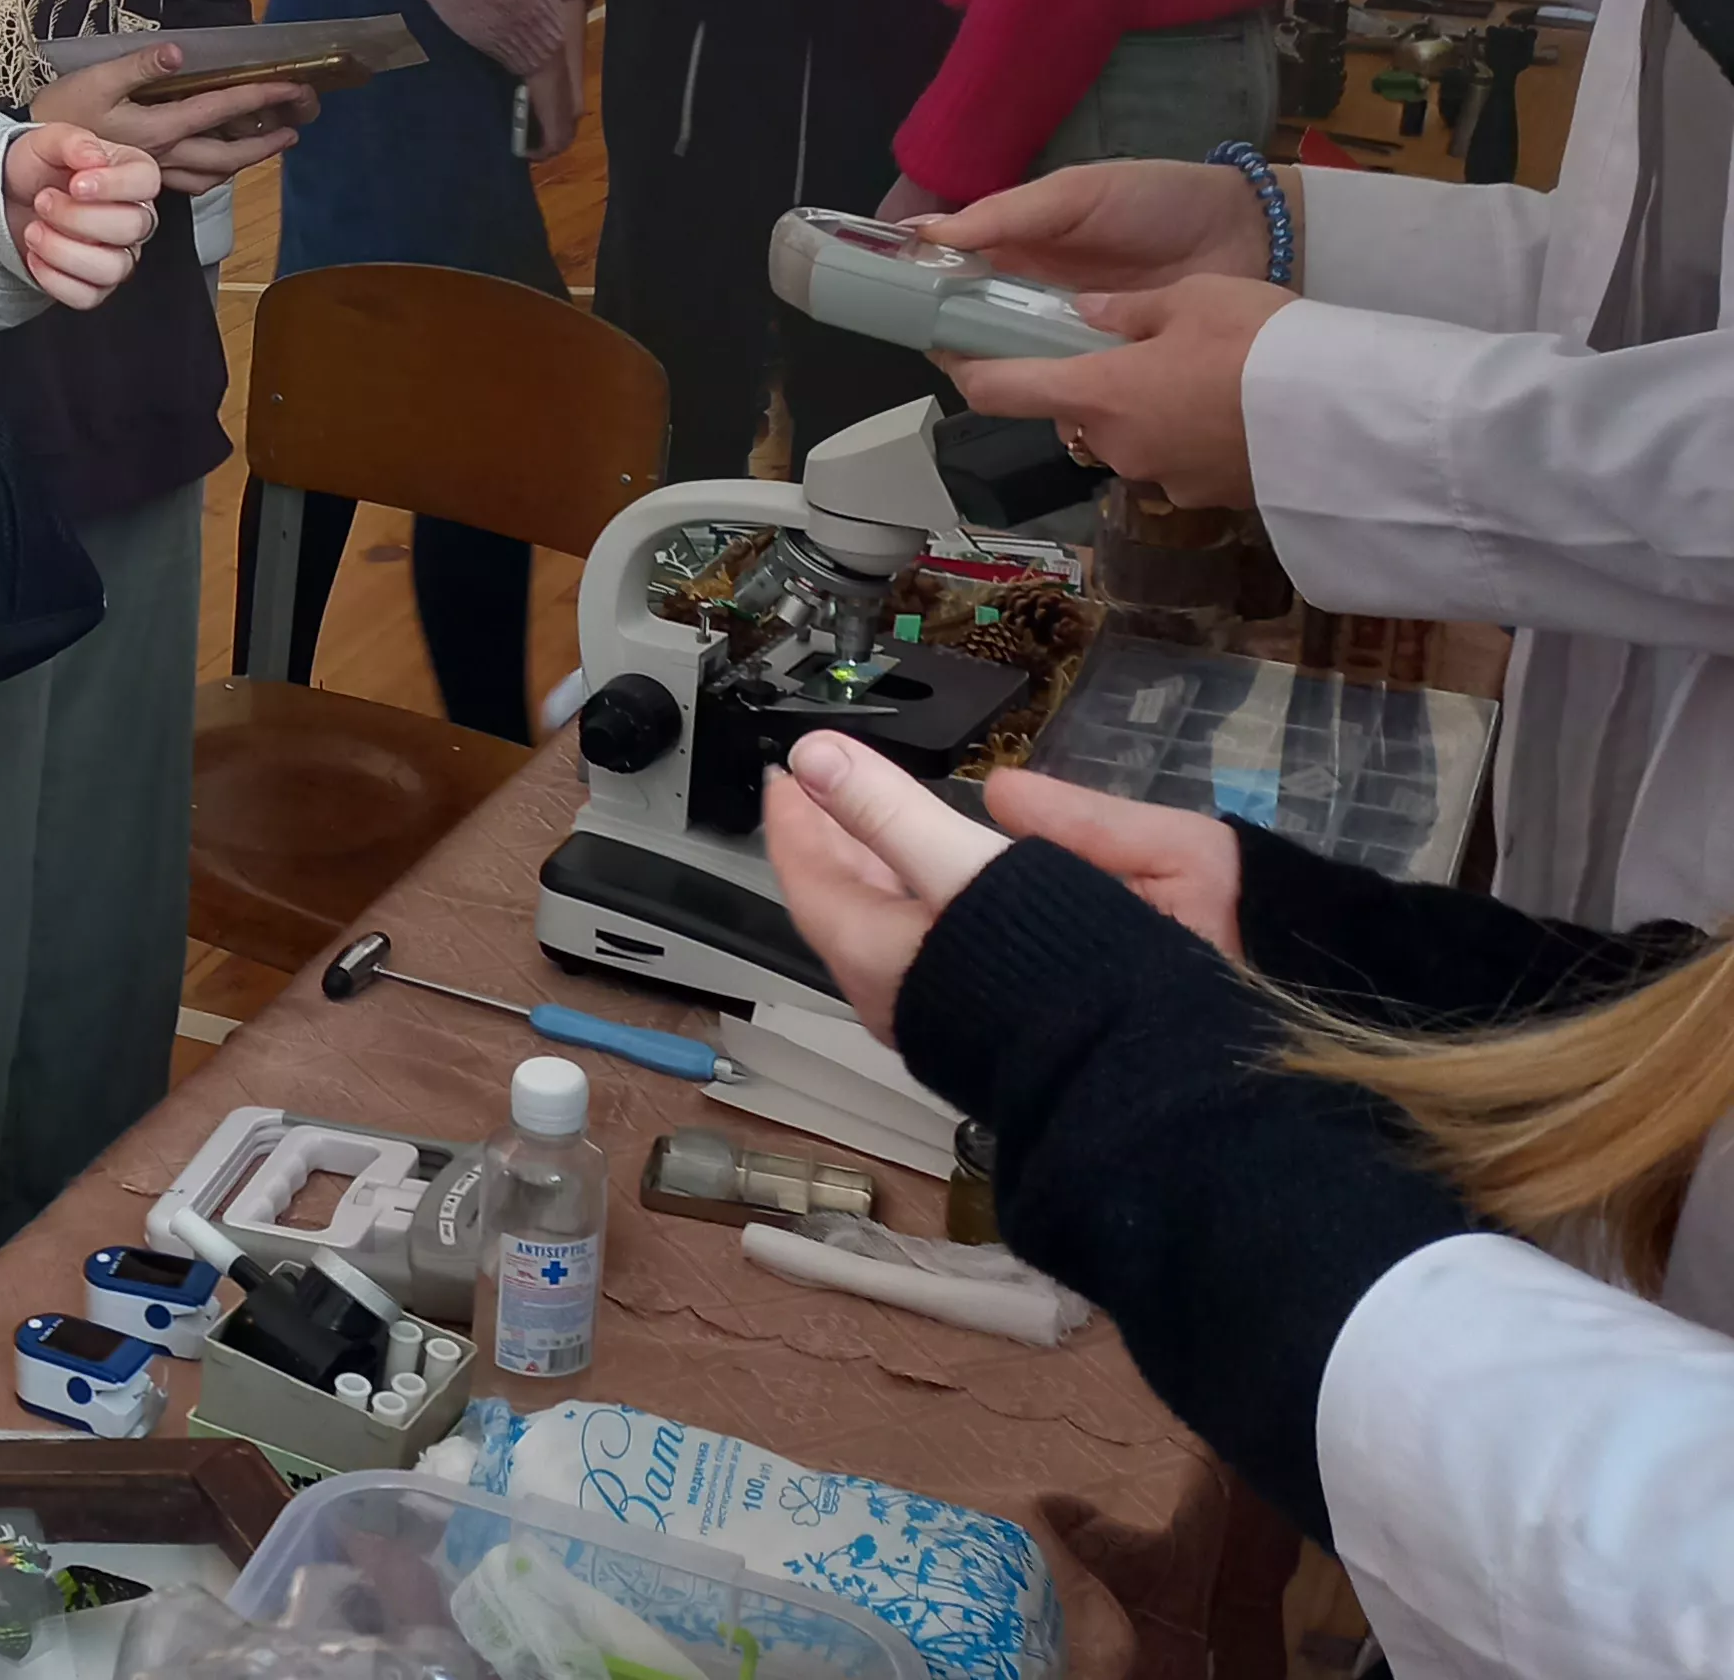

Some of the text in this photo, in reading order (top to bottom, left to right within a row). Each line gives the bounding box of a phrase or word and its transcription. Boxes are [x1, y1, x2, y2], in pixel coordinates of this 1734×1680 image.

[515, 1241, 588, 1259] ANTISEPTIC
[579, 1408, 686, 1534] Ват
[687, 1441, 710, 1505] медична
[742, 1477, 766, 1511] 100
